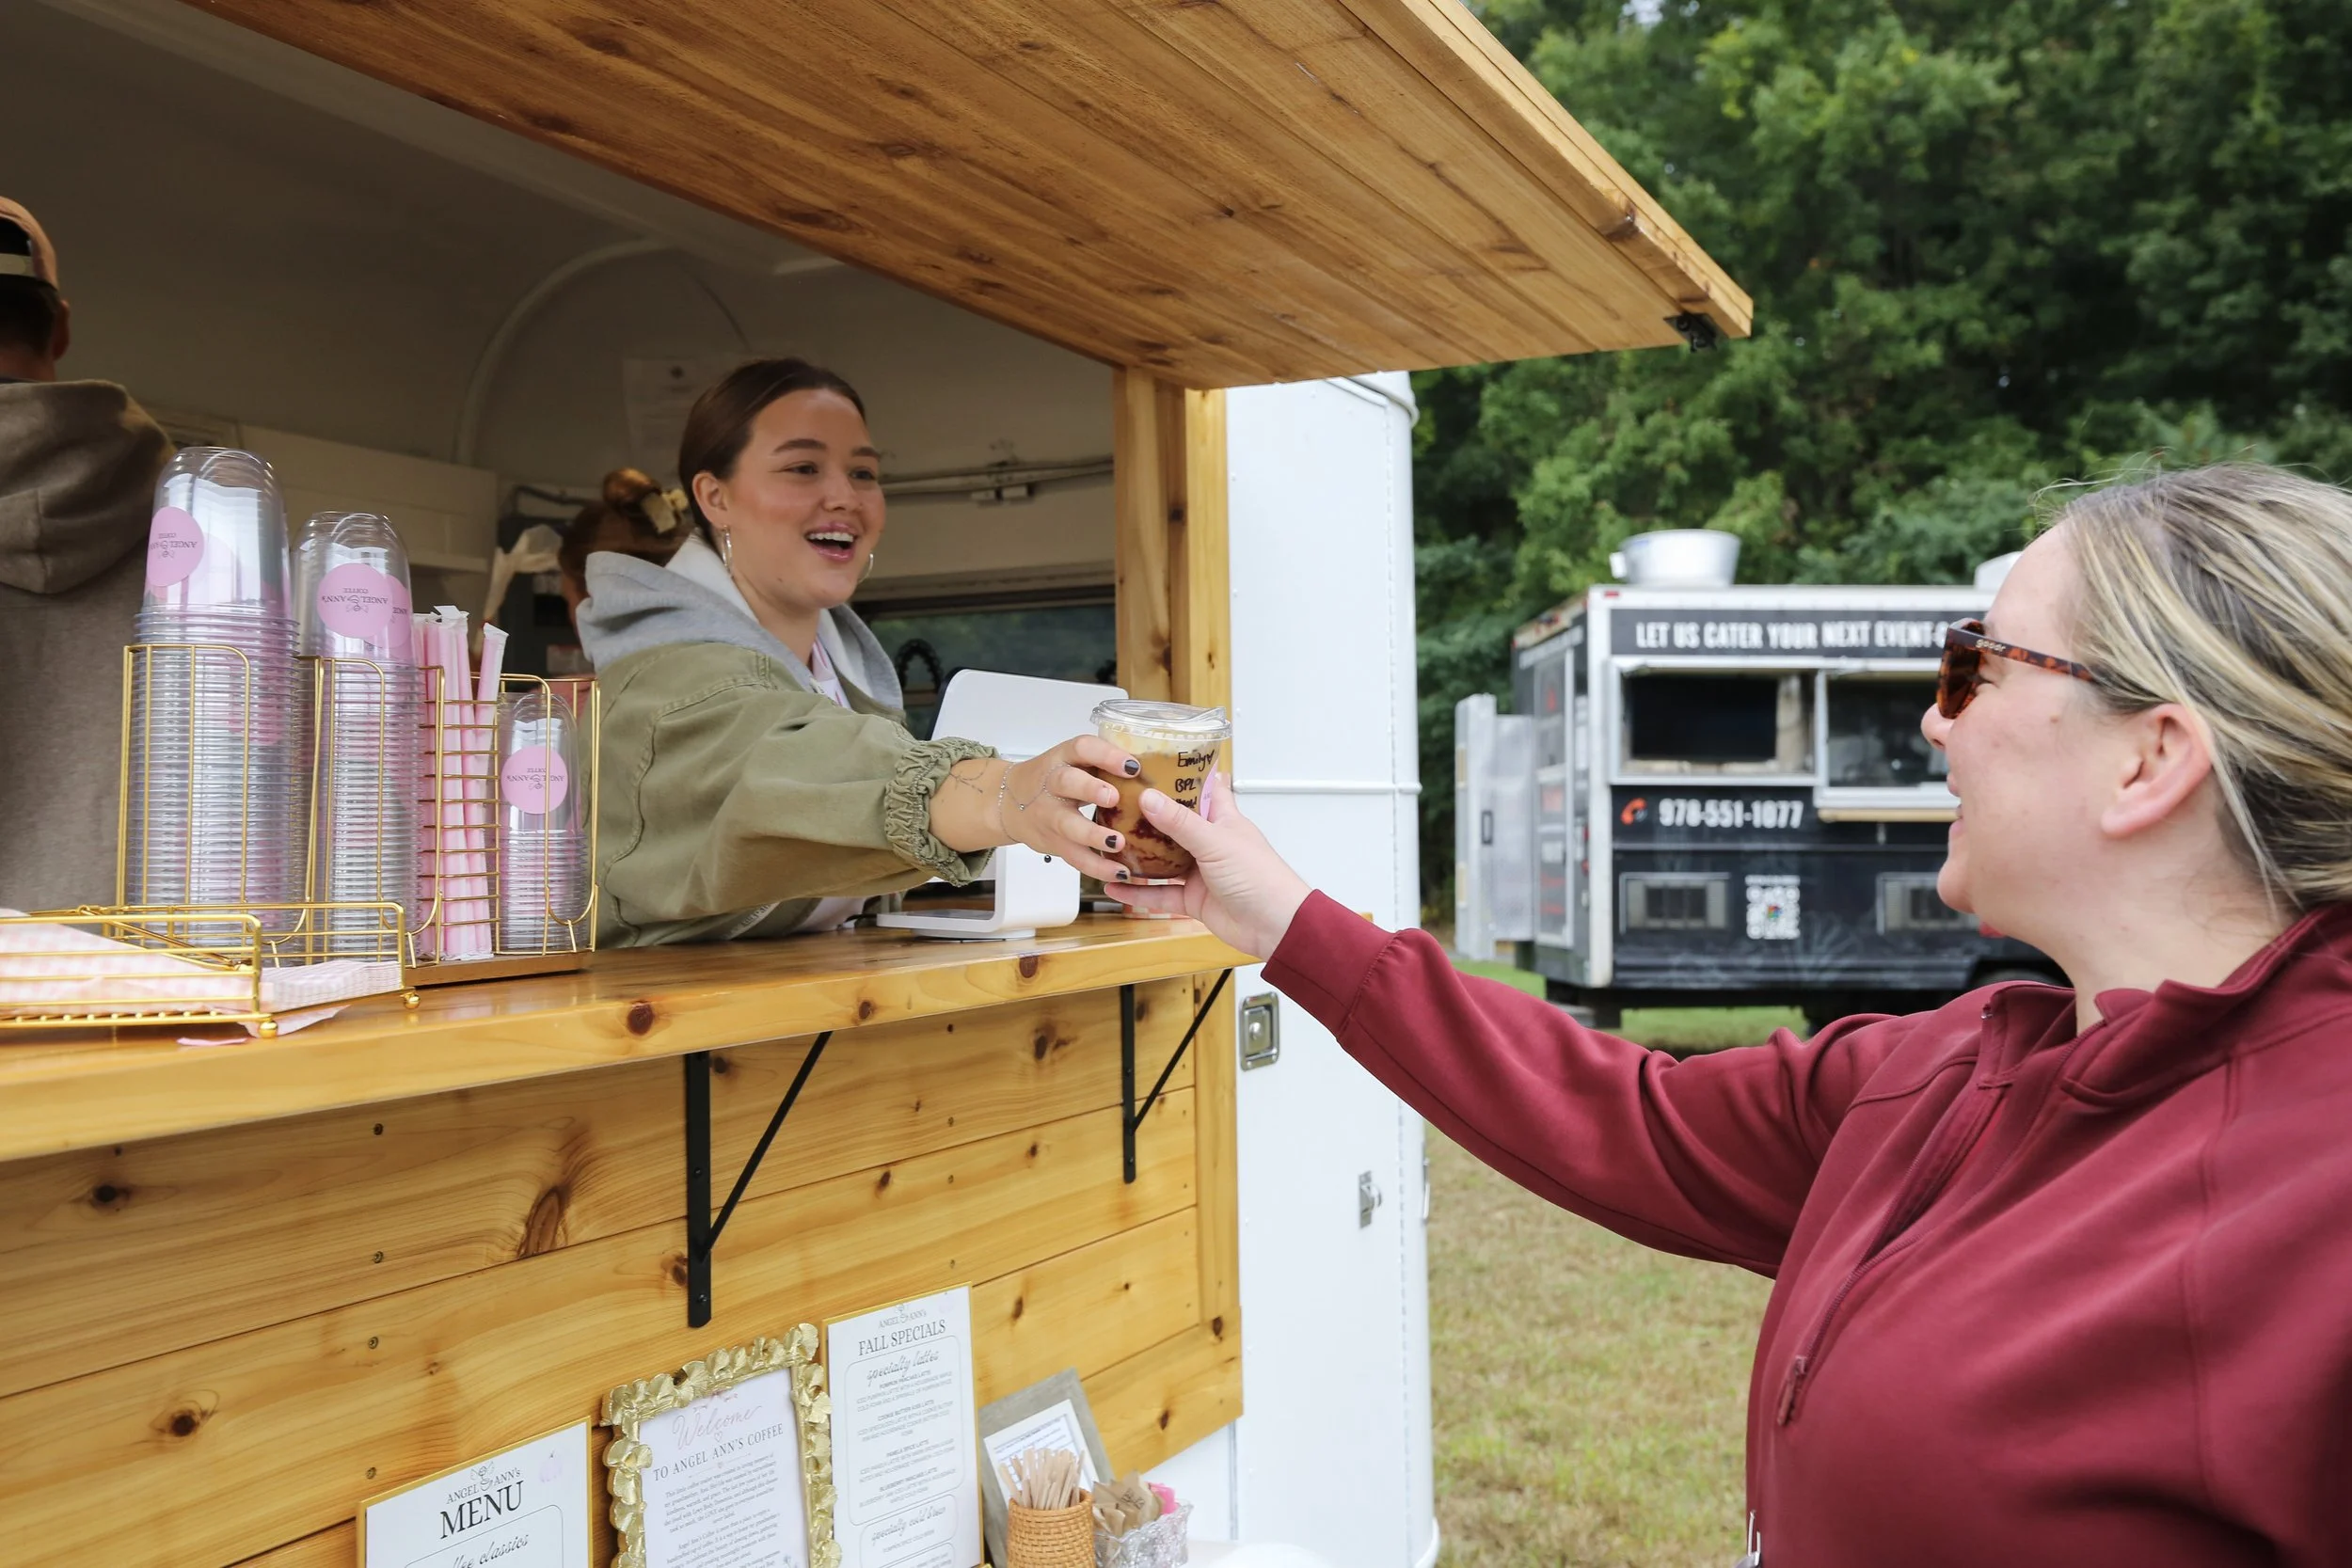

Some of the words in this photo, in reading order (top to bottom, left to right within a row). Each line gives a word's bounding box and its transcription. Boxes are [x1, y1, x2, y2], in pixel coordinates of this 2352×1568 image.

[360, 595, 388, 604] ANGEL
[1636, 622, 1671, 649] LET
[1674, 622, 1700, 649] US
[1704, 622, 1763, 649] CATER
[1767, 622, 1819, 649] YOUR
[1821, 621, 1871, 648] NEXT
[1976, 639, 2006, 652] goodr
[1177, 751, 1208, 772] Emily
[858, 1335, 889, 1356] FALL
[891, 1319, 946, 1347] SPECIALS
[867, 1355, 911, 1387] specialty
[913, 1349, 940, 1367] lattes
[672, 1406, 762, 1450] Welcome
[653, 1466, 668, 1481] TO
[672, 1451, 708, 1475] ANGEL
[712, 1438, 744, 1459] ANN'S
[747, 1423, 784, 1446] COFFEE
[446, 1484, 480, 1505] ANGEL
[493, 1467, 521, 1487] ANN's
[439, 1481, 524, 1539] MENU
[479, 1535, 529, 1565] classics
